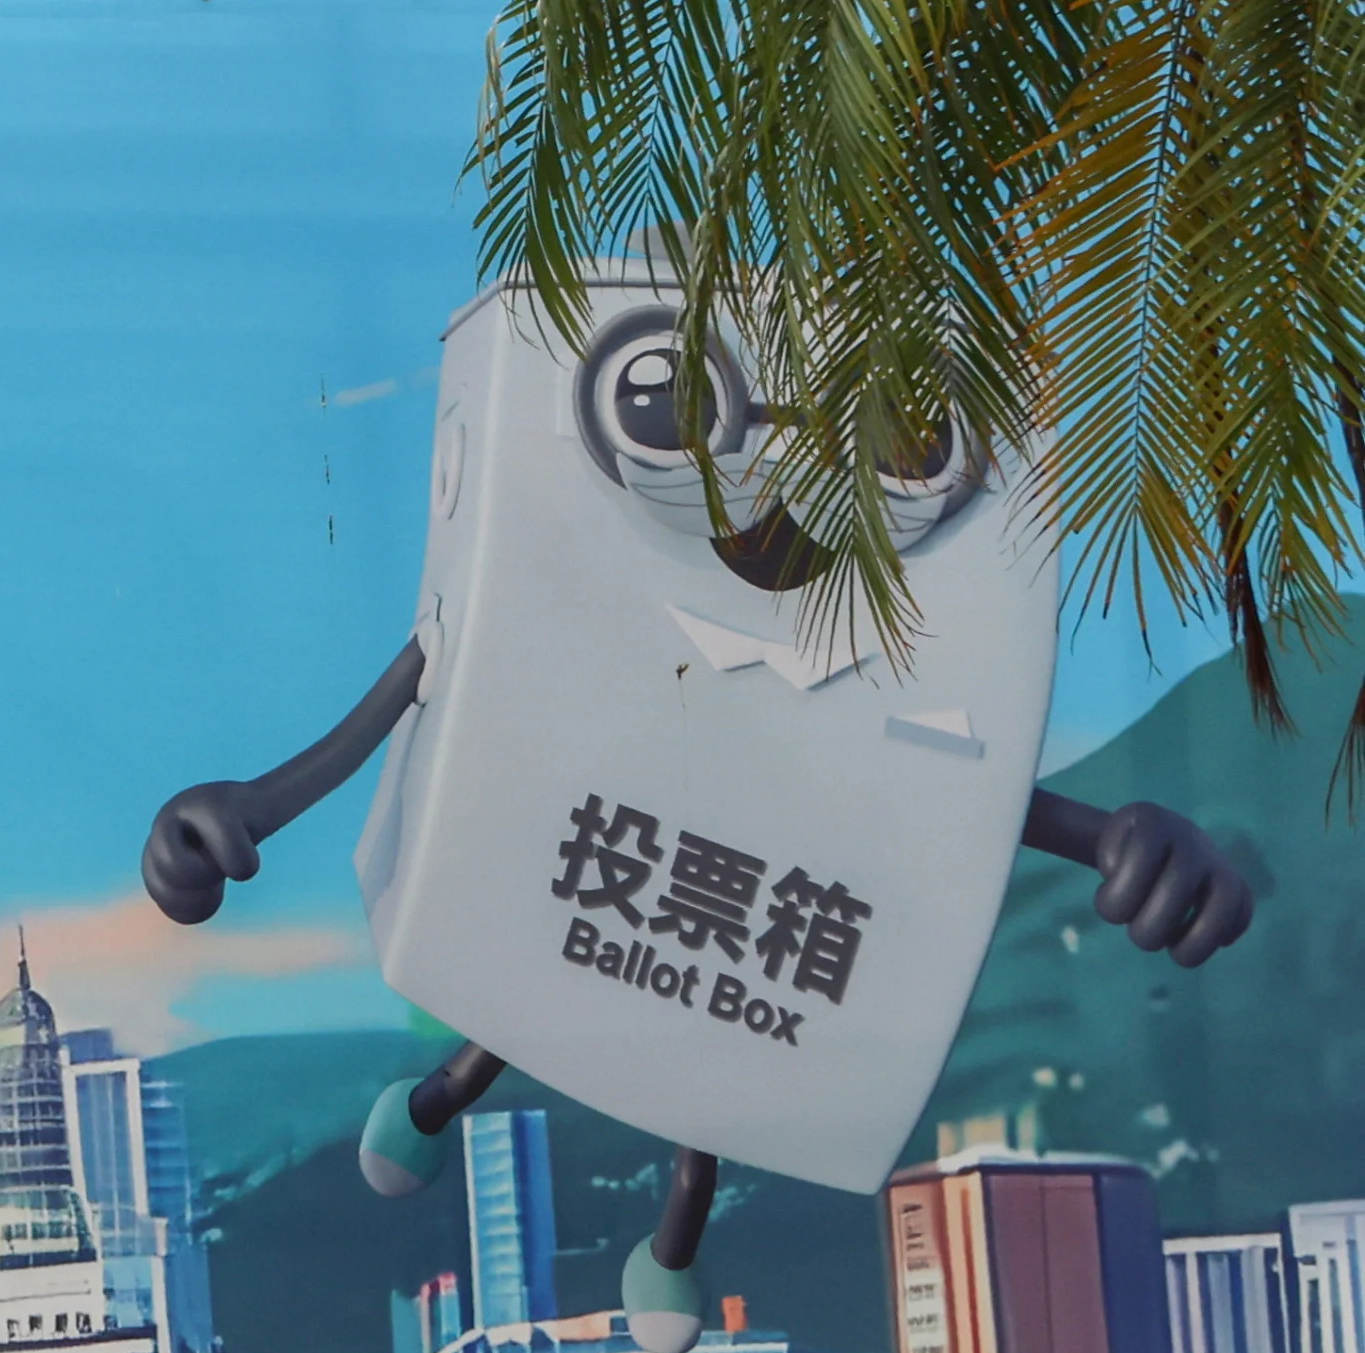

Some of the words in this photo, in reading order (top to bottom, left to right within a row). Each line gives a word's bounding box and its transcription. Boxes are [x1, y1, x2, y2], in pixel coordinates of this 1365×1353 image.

[551, 792, 873, 1006] 投票箱
[562, 916, 701, 1009] Ballot
[707, 972, 805, 1047] Box
